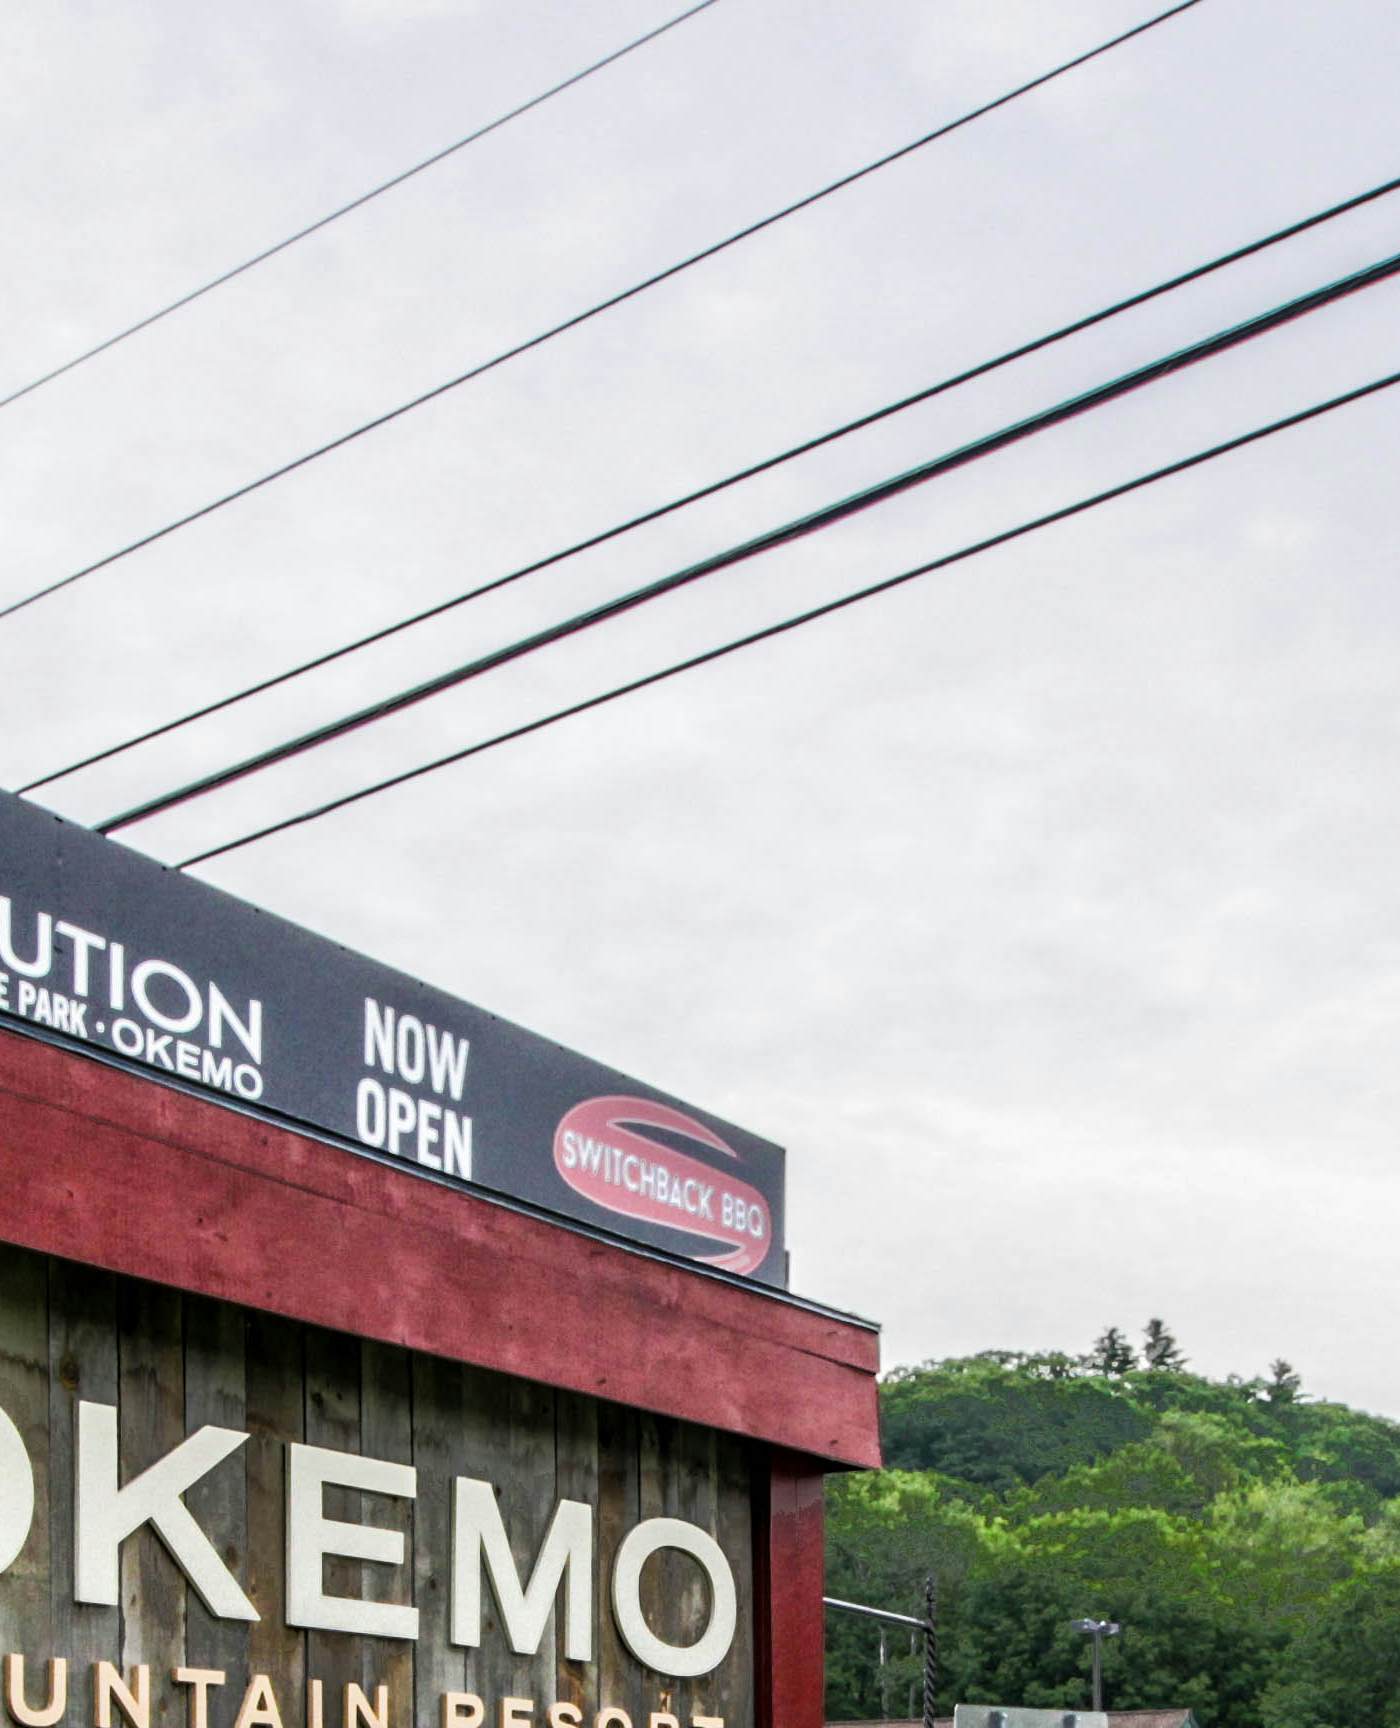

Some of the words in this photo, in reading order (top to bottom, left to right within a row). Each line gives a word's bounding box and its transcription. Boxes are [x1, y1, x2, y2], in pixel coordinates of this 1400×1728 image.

[0, 895, 263, 1065] UTION
[18, 980, 88, 1039] PARK
[111, 1018, 264, 1100] OKEMO
[364, 997, 470, 1100] NOW
[357, 1078, 473, 1181] OPEN
[562, 1131, 715, 1221] SWITCHBACK
[721, 1192, 765, 1238] BBQ
[0, 1400, 737, 1677] KEMO
